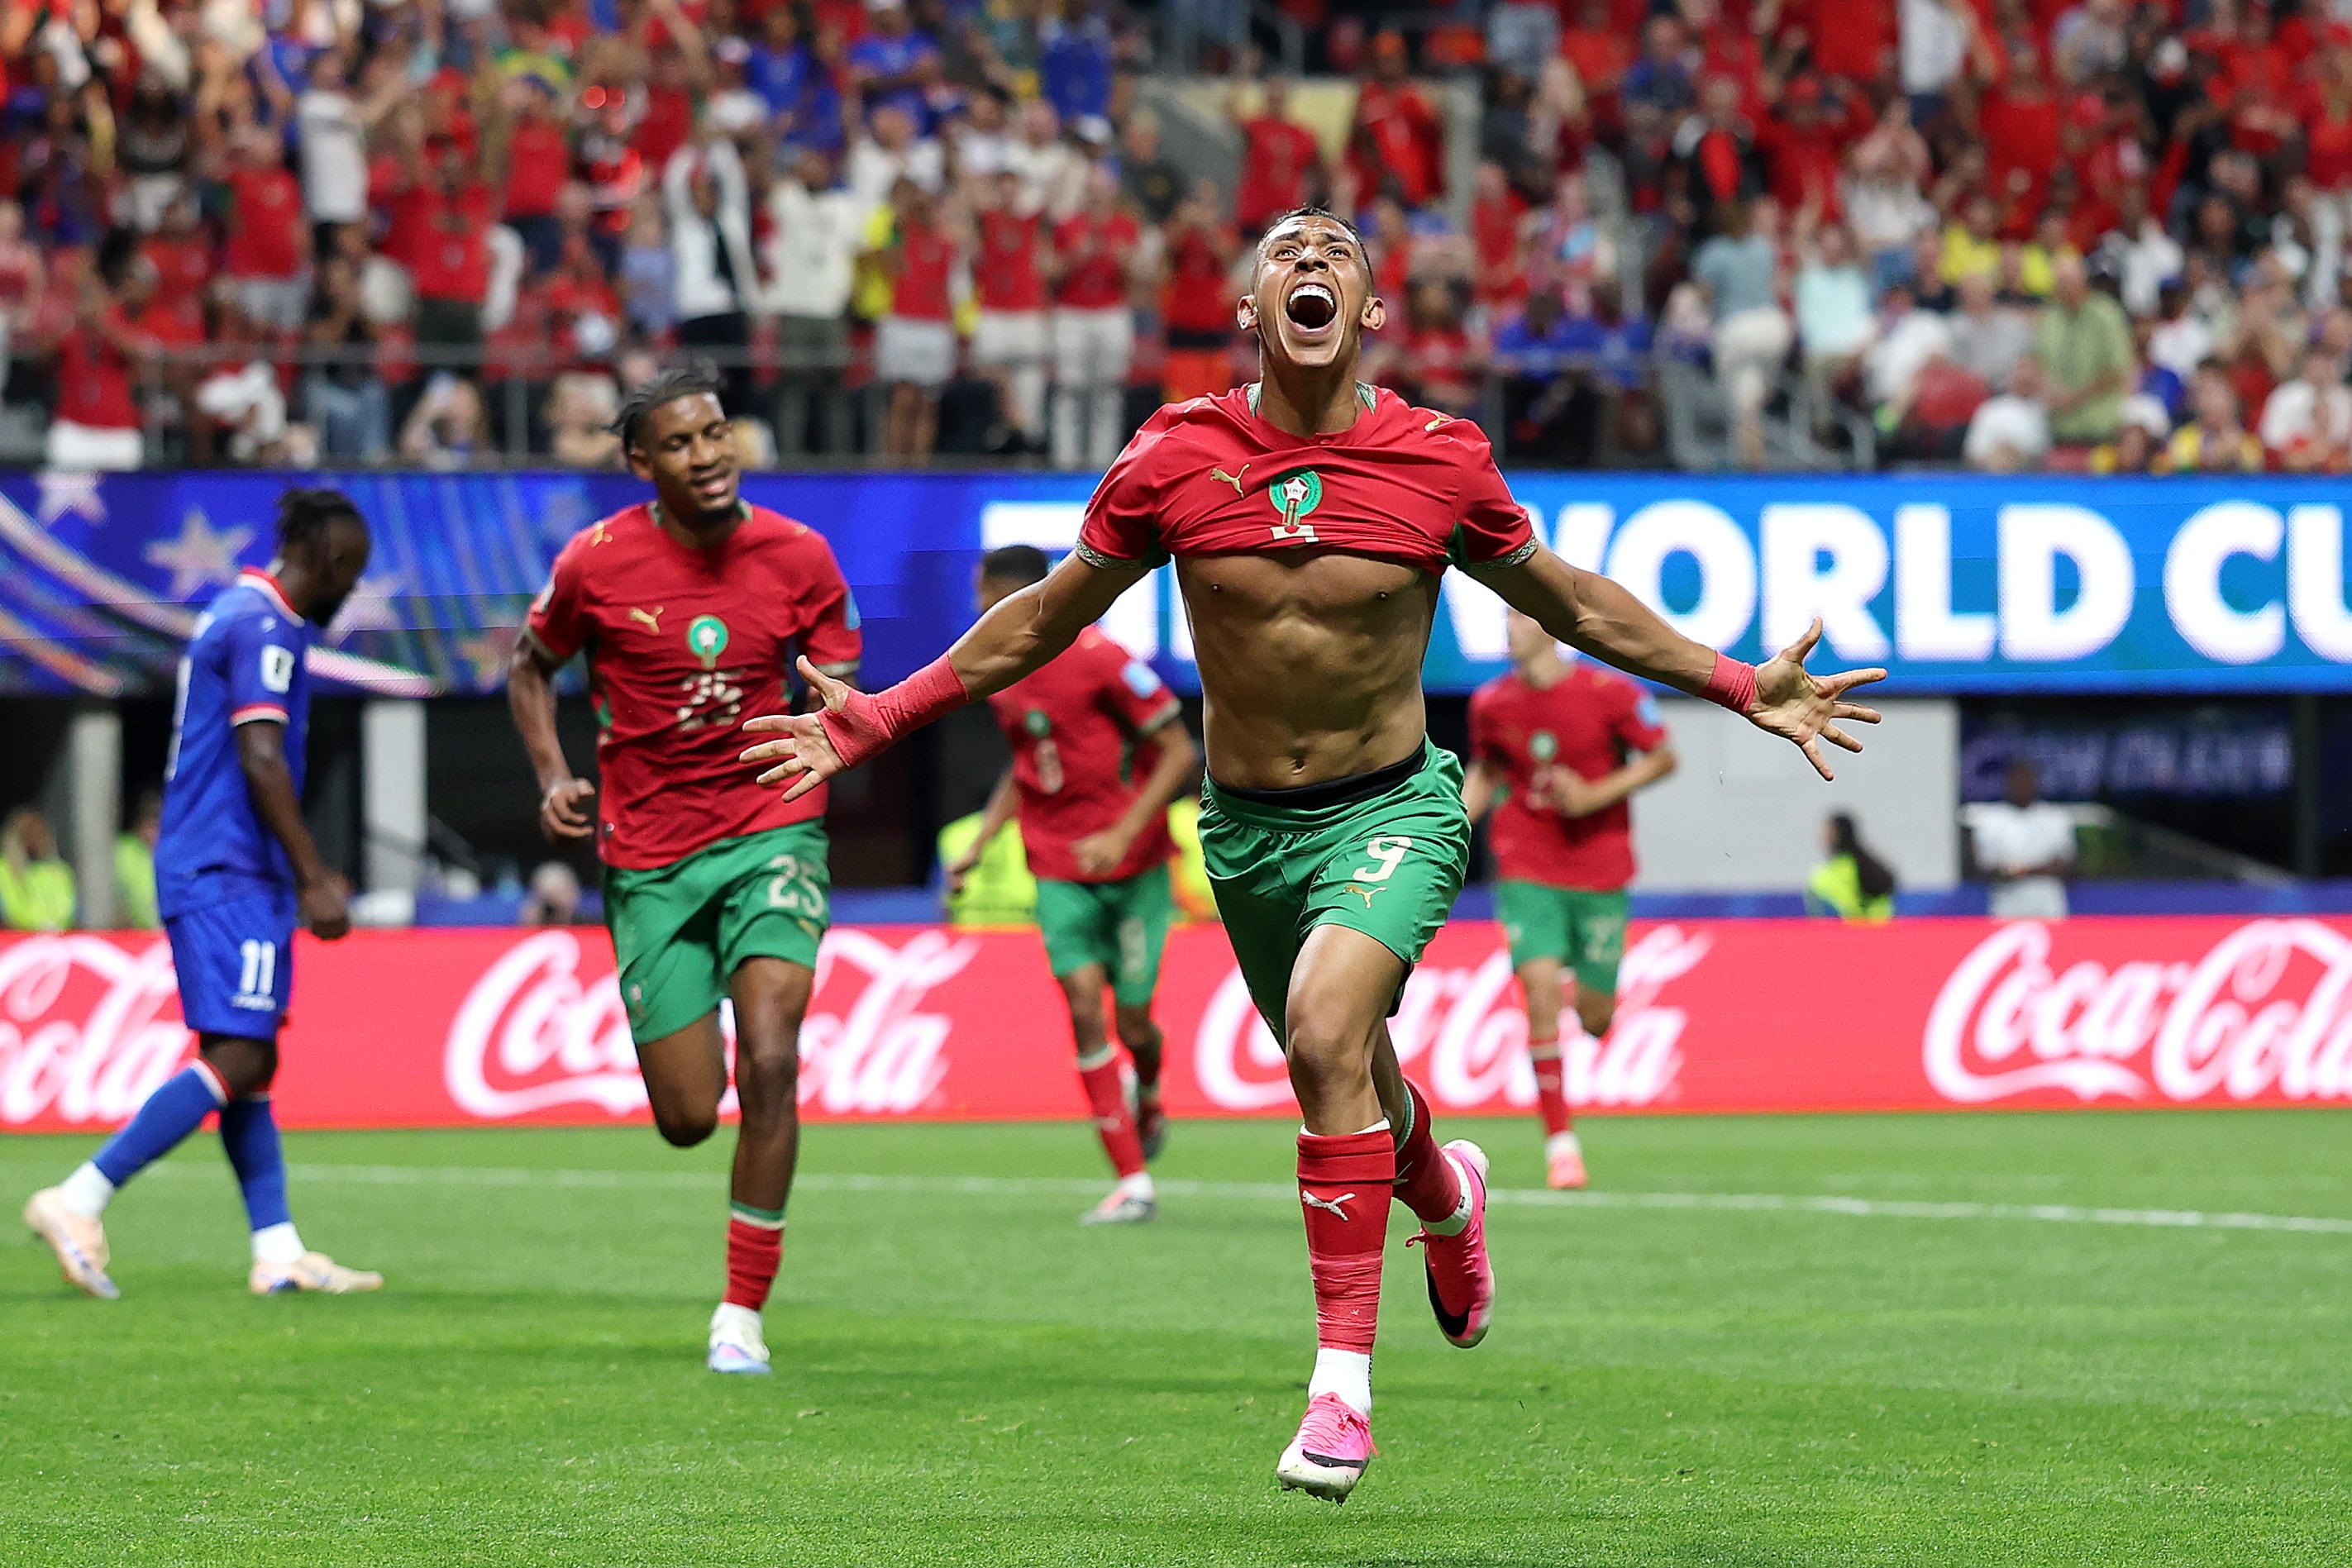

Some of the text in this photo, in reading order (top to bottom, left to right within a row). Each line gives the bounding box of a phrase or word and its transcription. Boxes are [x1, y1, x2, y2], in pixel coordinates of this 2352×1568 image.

[769, 854, 824, 918] 25
[1353, 836, 1413, 883] 9
[240, 937, 276, 995] 11
[443, 928, 985, 1118] Cocla
